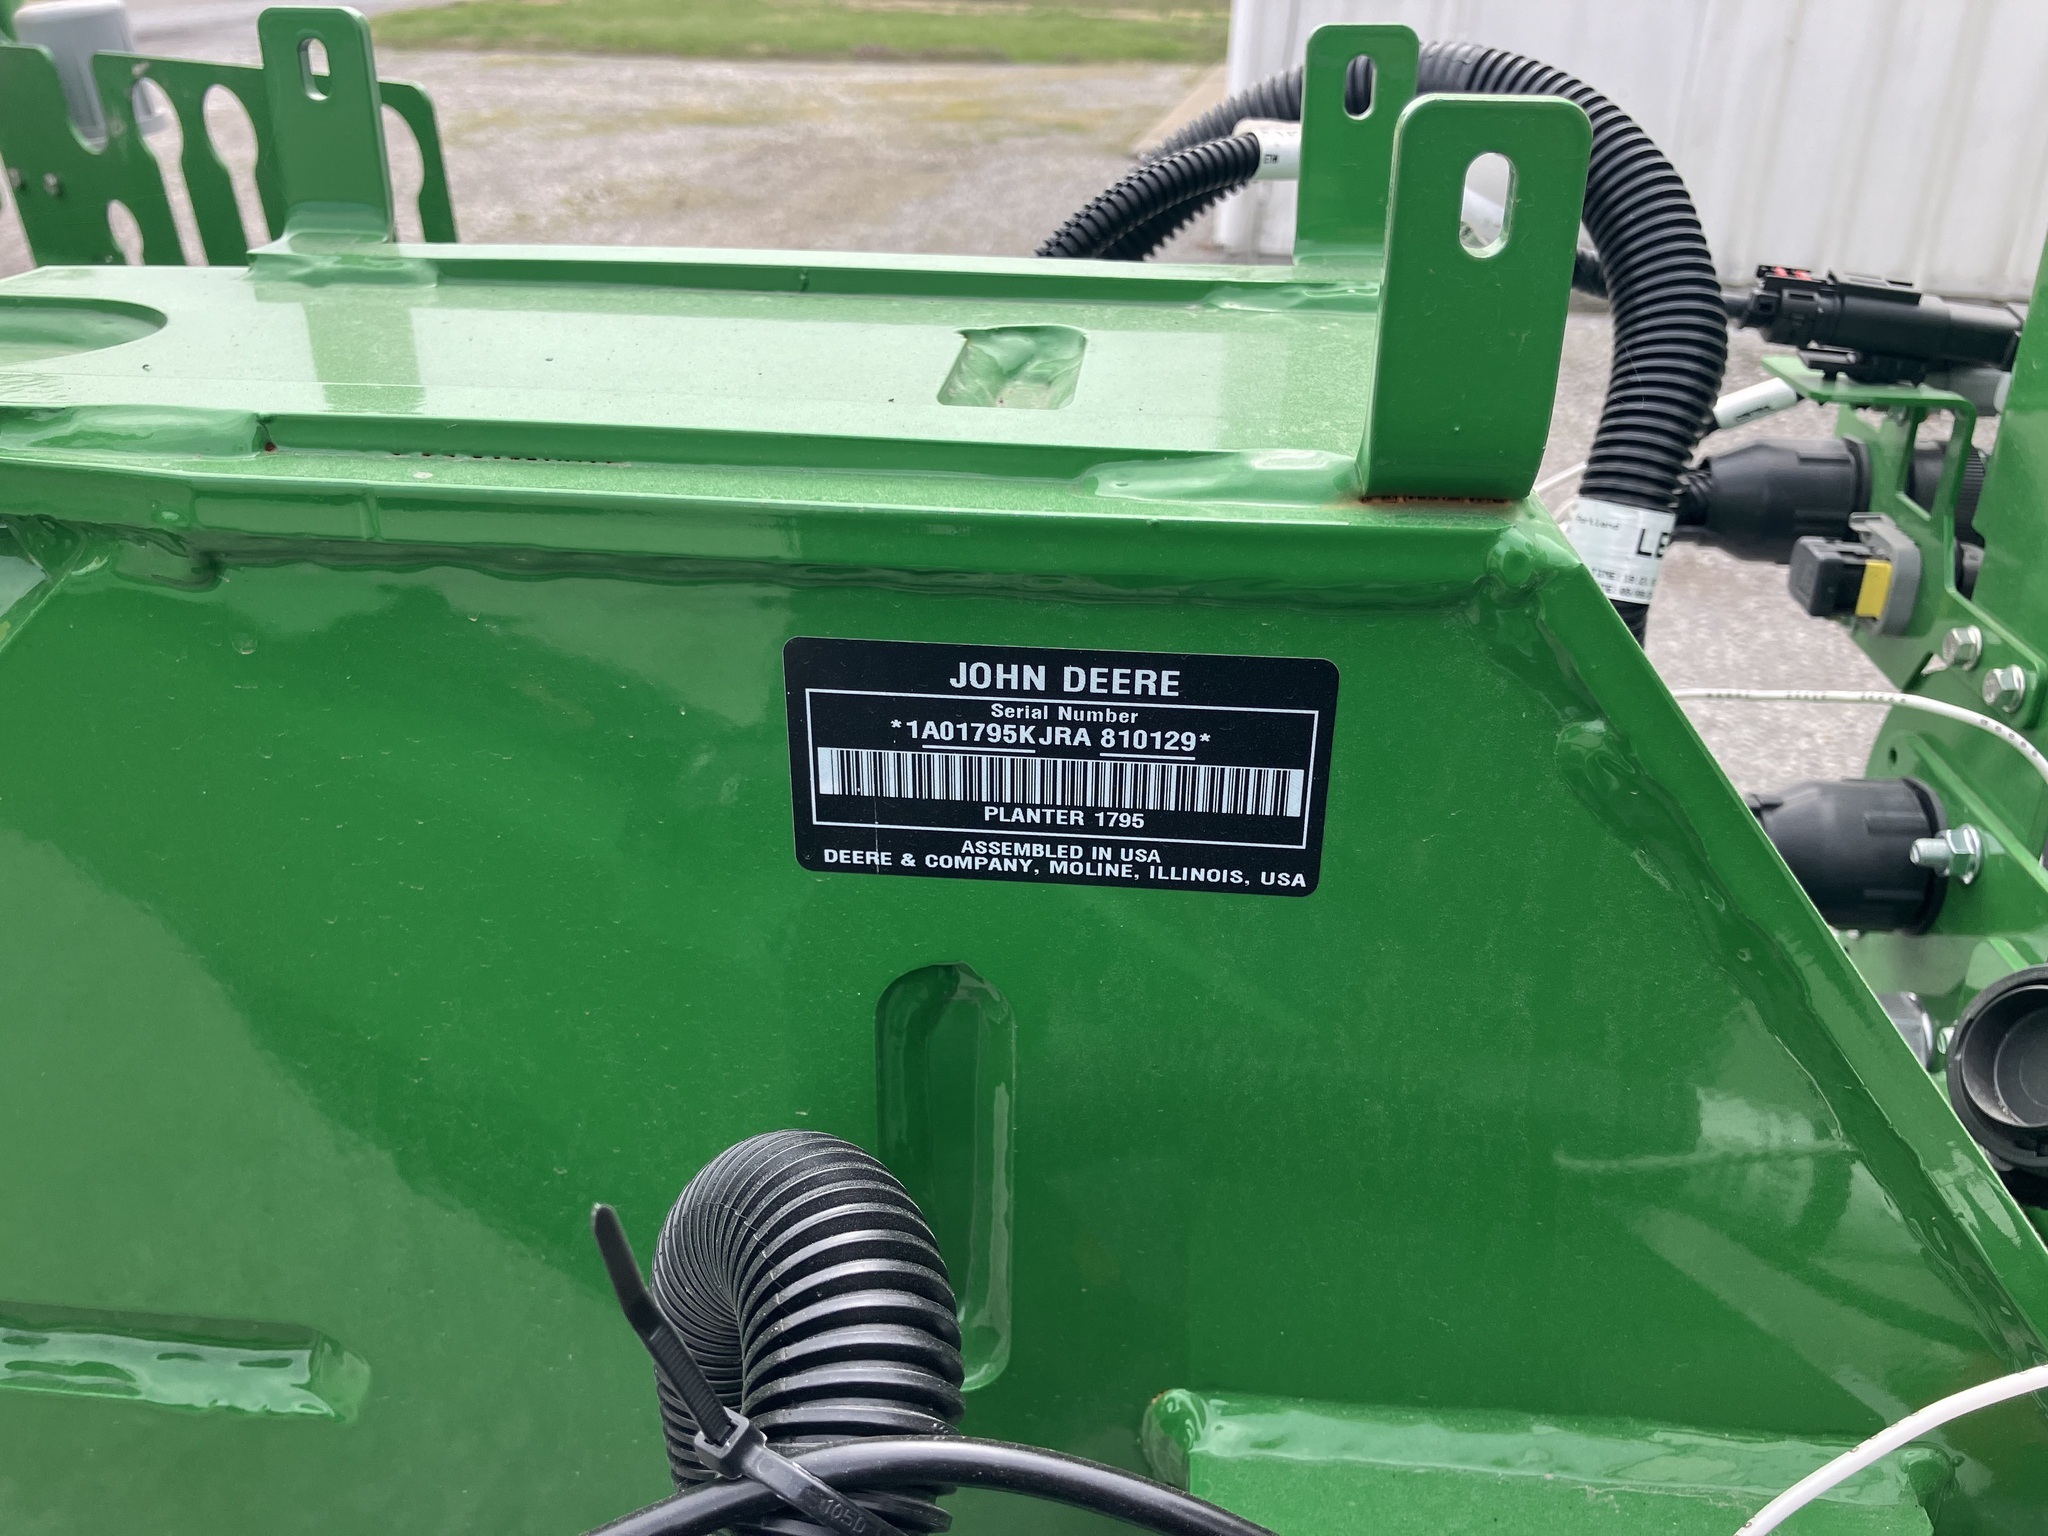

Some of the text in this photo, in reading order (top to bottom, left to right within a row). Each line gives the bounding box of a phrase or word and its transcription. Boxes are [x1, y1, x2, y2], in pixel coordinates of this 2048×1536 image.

[950, 661, 1181, 697] JOHN DEERE
[990, 702, 1139, 724] Serial Number
[984, 805, 1145, 829] PLANTER 1795
[960, 839, 1162, 864] ASSEMBLED IN USA
[823, 848, 1307, 889] DEERE & COMPANY, MOLINE, ILLINOIS, USA
